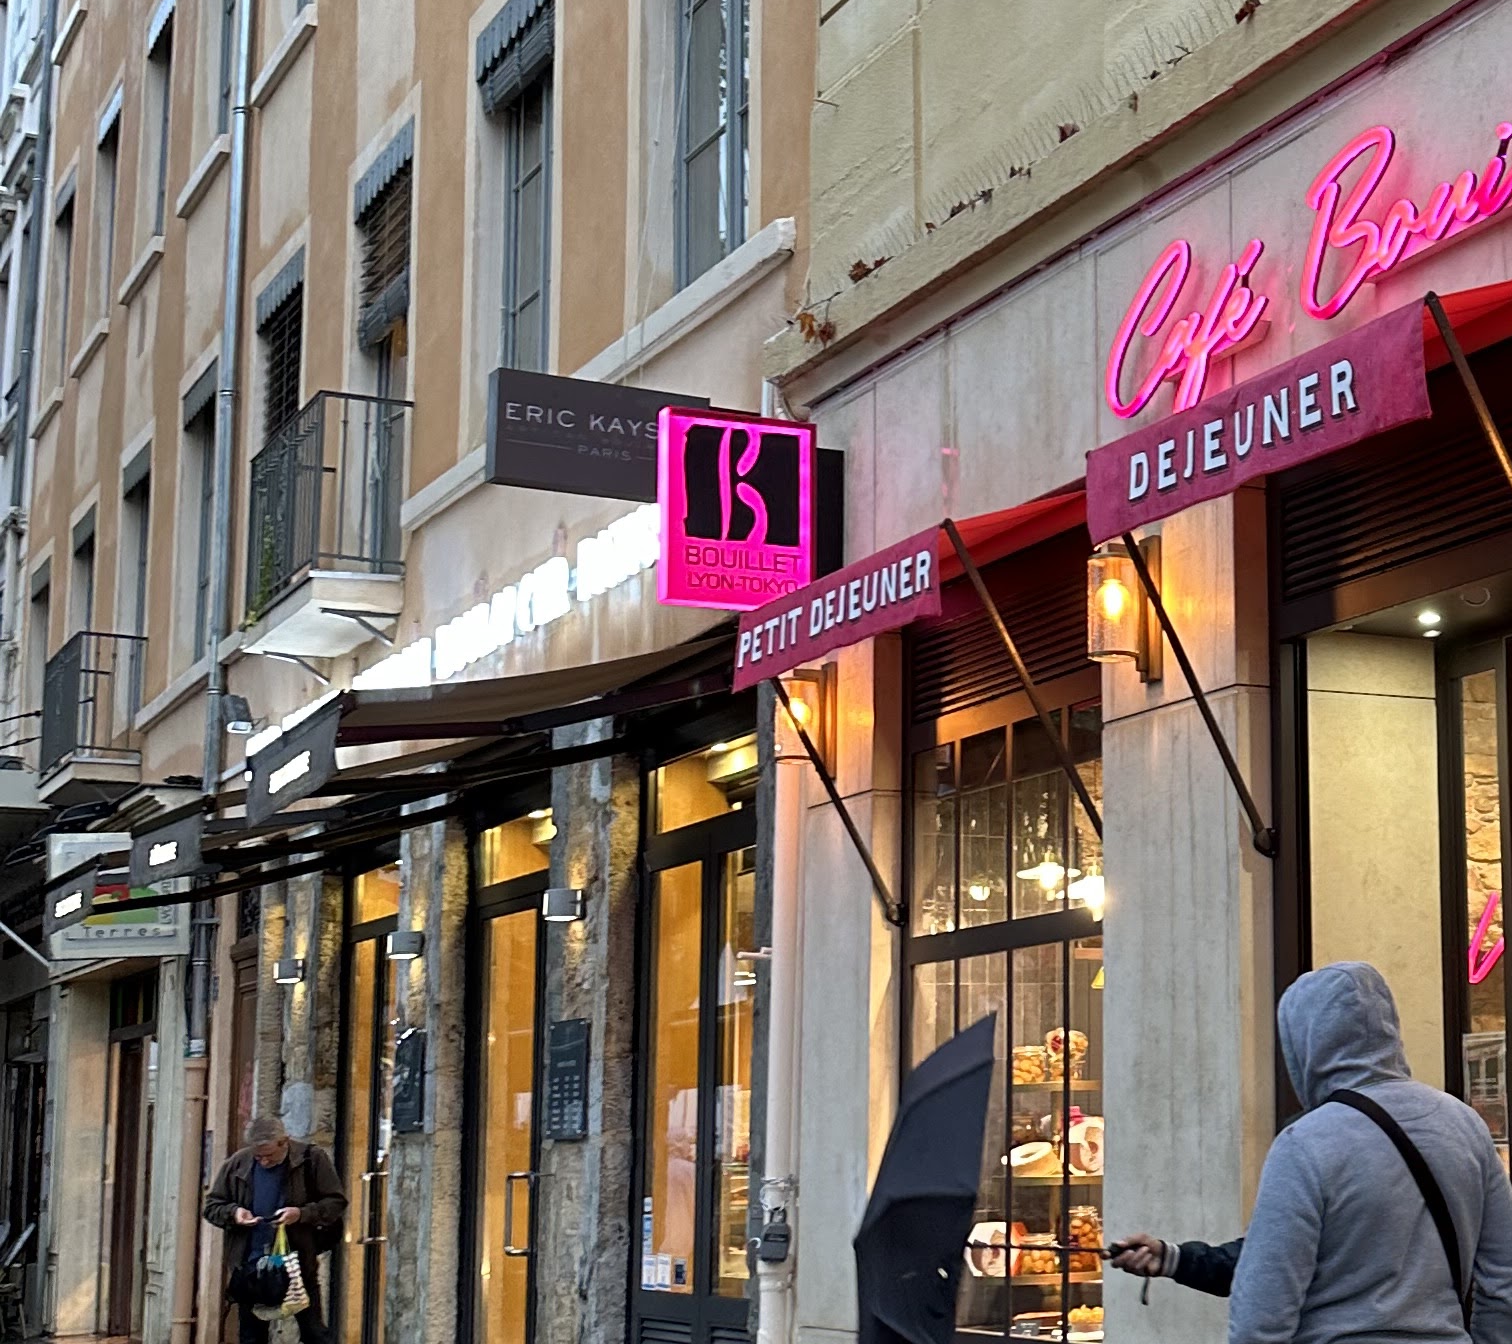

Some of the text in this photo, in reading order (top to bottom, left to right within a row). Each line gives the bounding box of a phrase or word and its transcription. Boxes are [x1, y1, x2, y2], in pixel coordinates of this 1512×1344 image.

[1105, 239, 1270, 419] Café
[505, 401, 576, 428] ERIC
[1128, 357, 1357, 502] DEJEUNER
[577, 444, 632, 462] PARIS
[685, 545, 803, 574] BOUILLET
[687, 572, 799, 595] LYON-TOKYO
[737, 550, 932, 668] PETIT DEJEUNER
[83, 926, 162, 938] Terres
